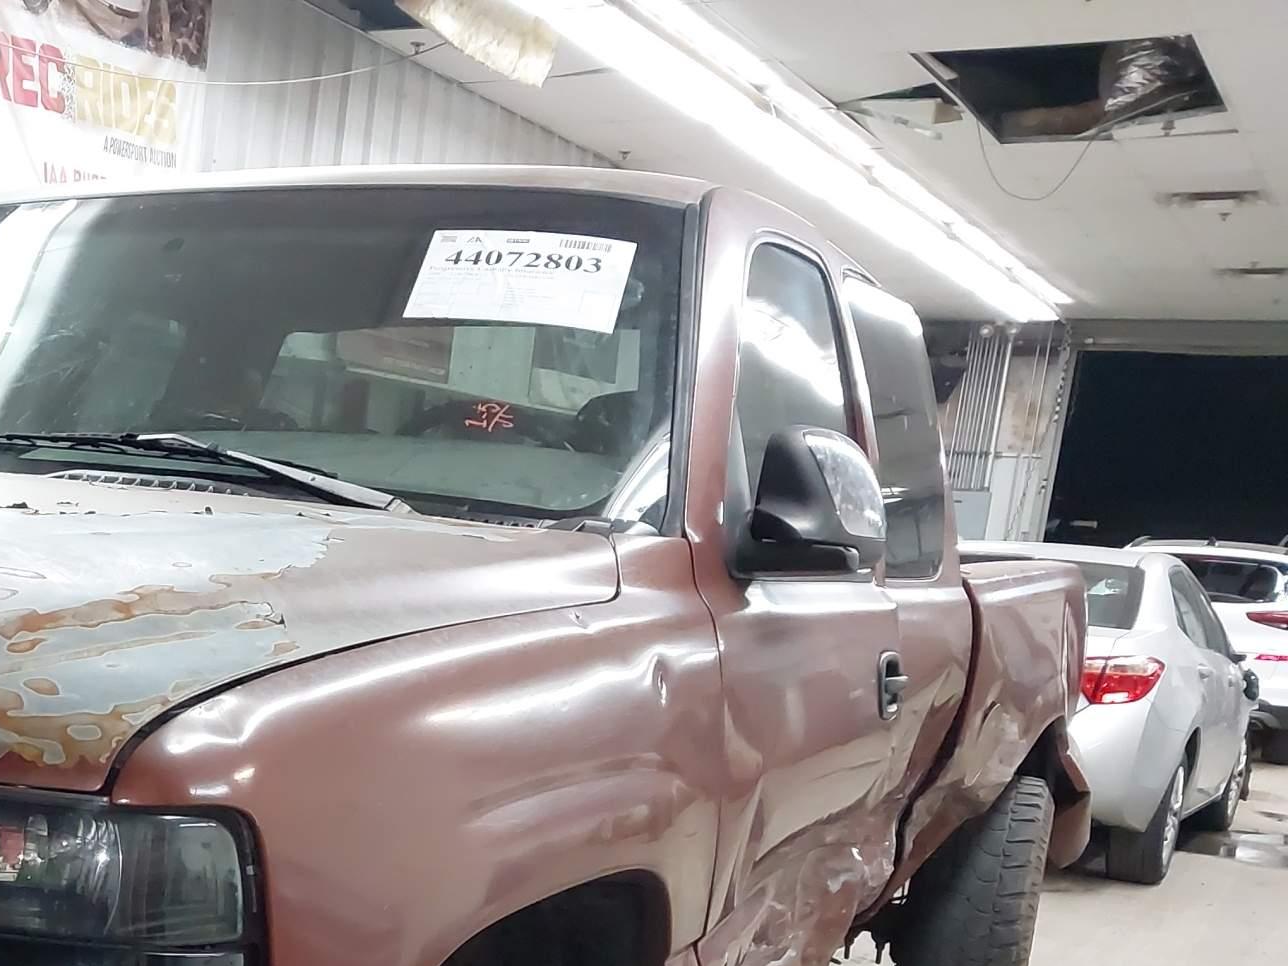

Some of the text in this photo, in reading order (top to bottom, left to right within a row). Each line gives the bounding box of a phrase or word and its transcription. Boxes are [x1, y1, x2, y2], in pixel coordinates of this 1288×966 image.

[73, 54, 177, 145] RIDES
[103, 135, 177, 169] A POWERSPORT AUCTION
[43, 161, 68, 184] IAA
[445, 249, 602, 274] 44072803
